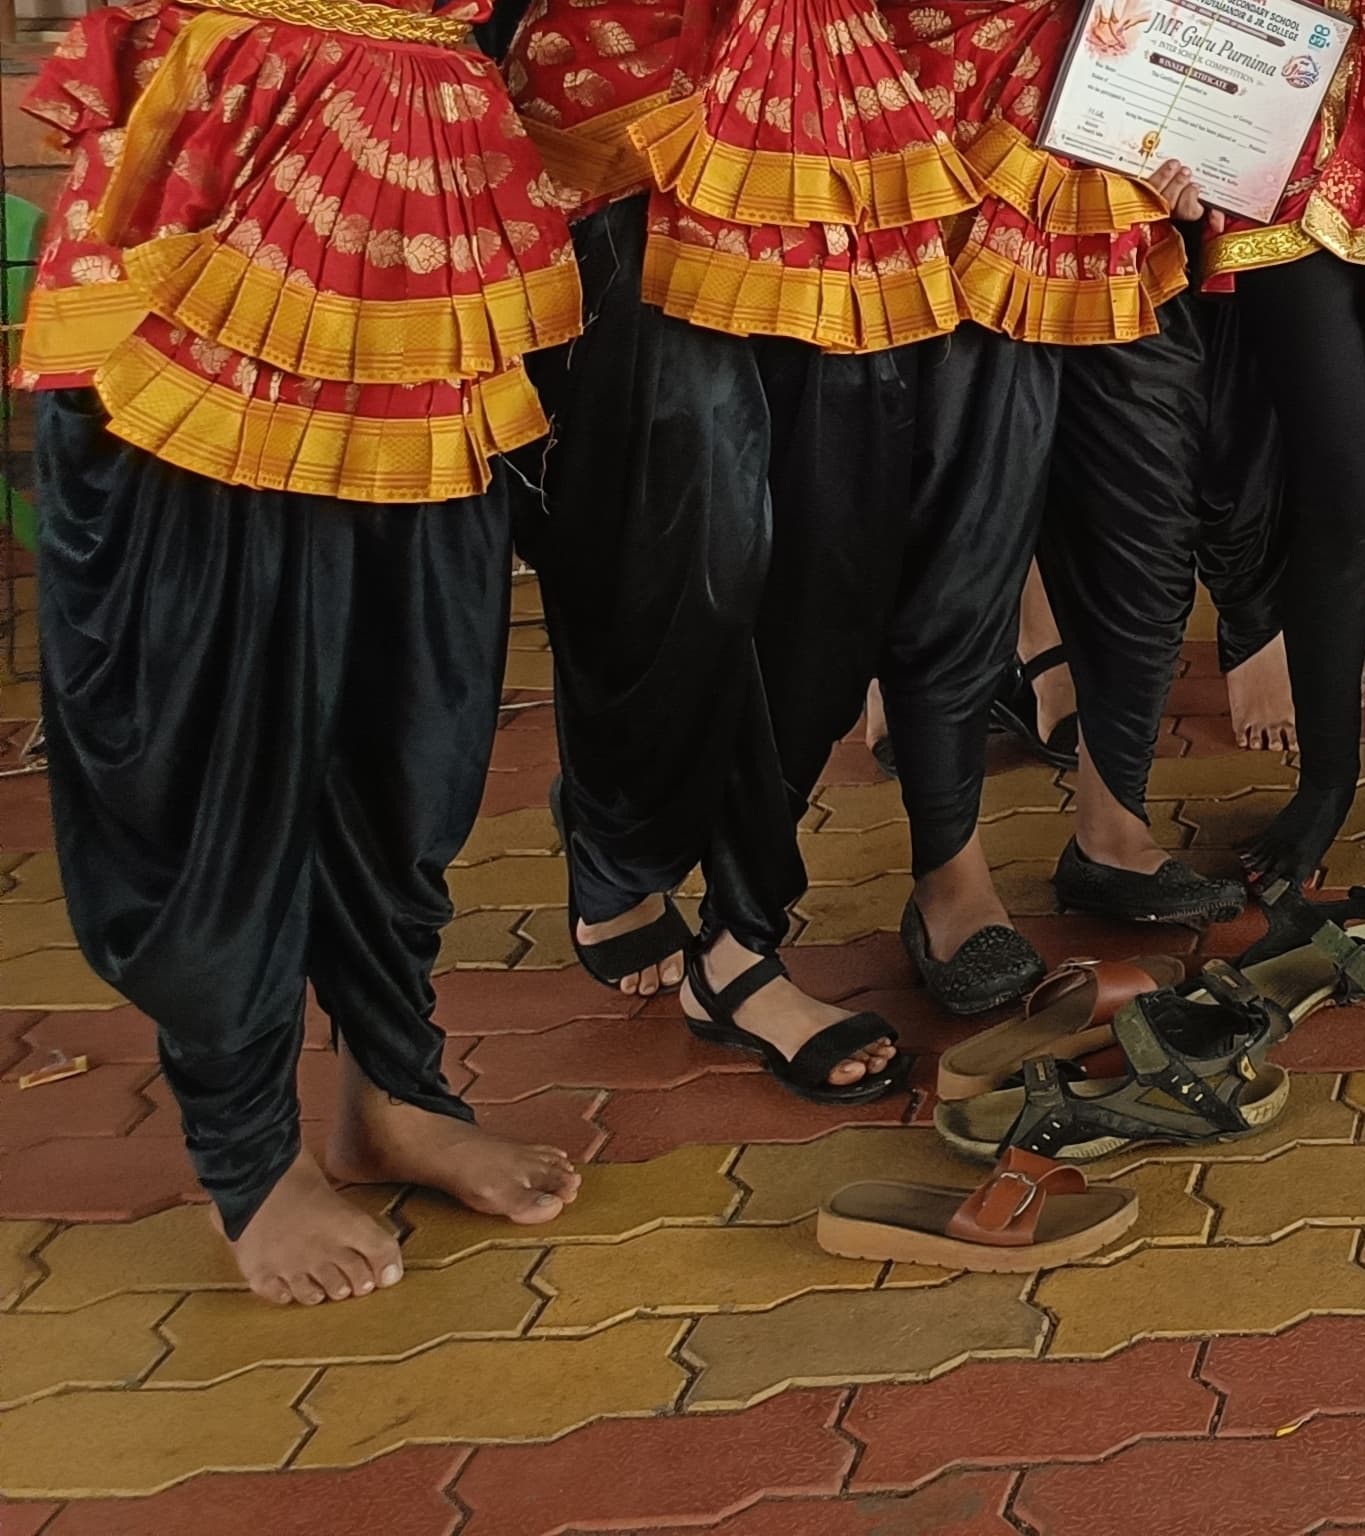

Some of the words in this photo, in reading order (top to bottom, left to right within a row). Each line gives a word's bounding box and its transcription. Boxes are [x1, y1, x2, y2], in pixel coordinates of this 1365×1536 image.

[1265, 20, 1299, 42] COLLEGE
[1269, 10, 1302, 32] SCHOOL
[1143, 8, 1184, 46] JMF
[1177, 22, 1219, 59] Guru
[1216, 38, 1279, 79] Purnima
